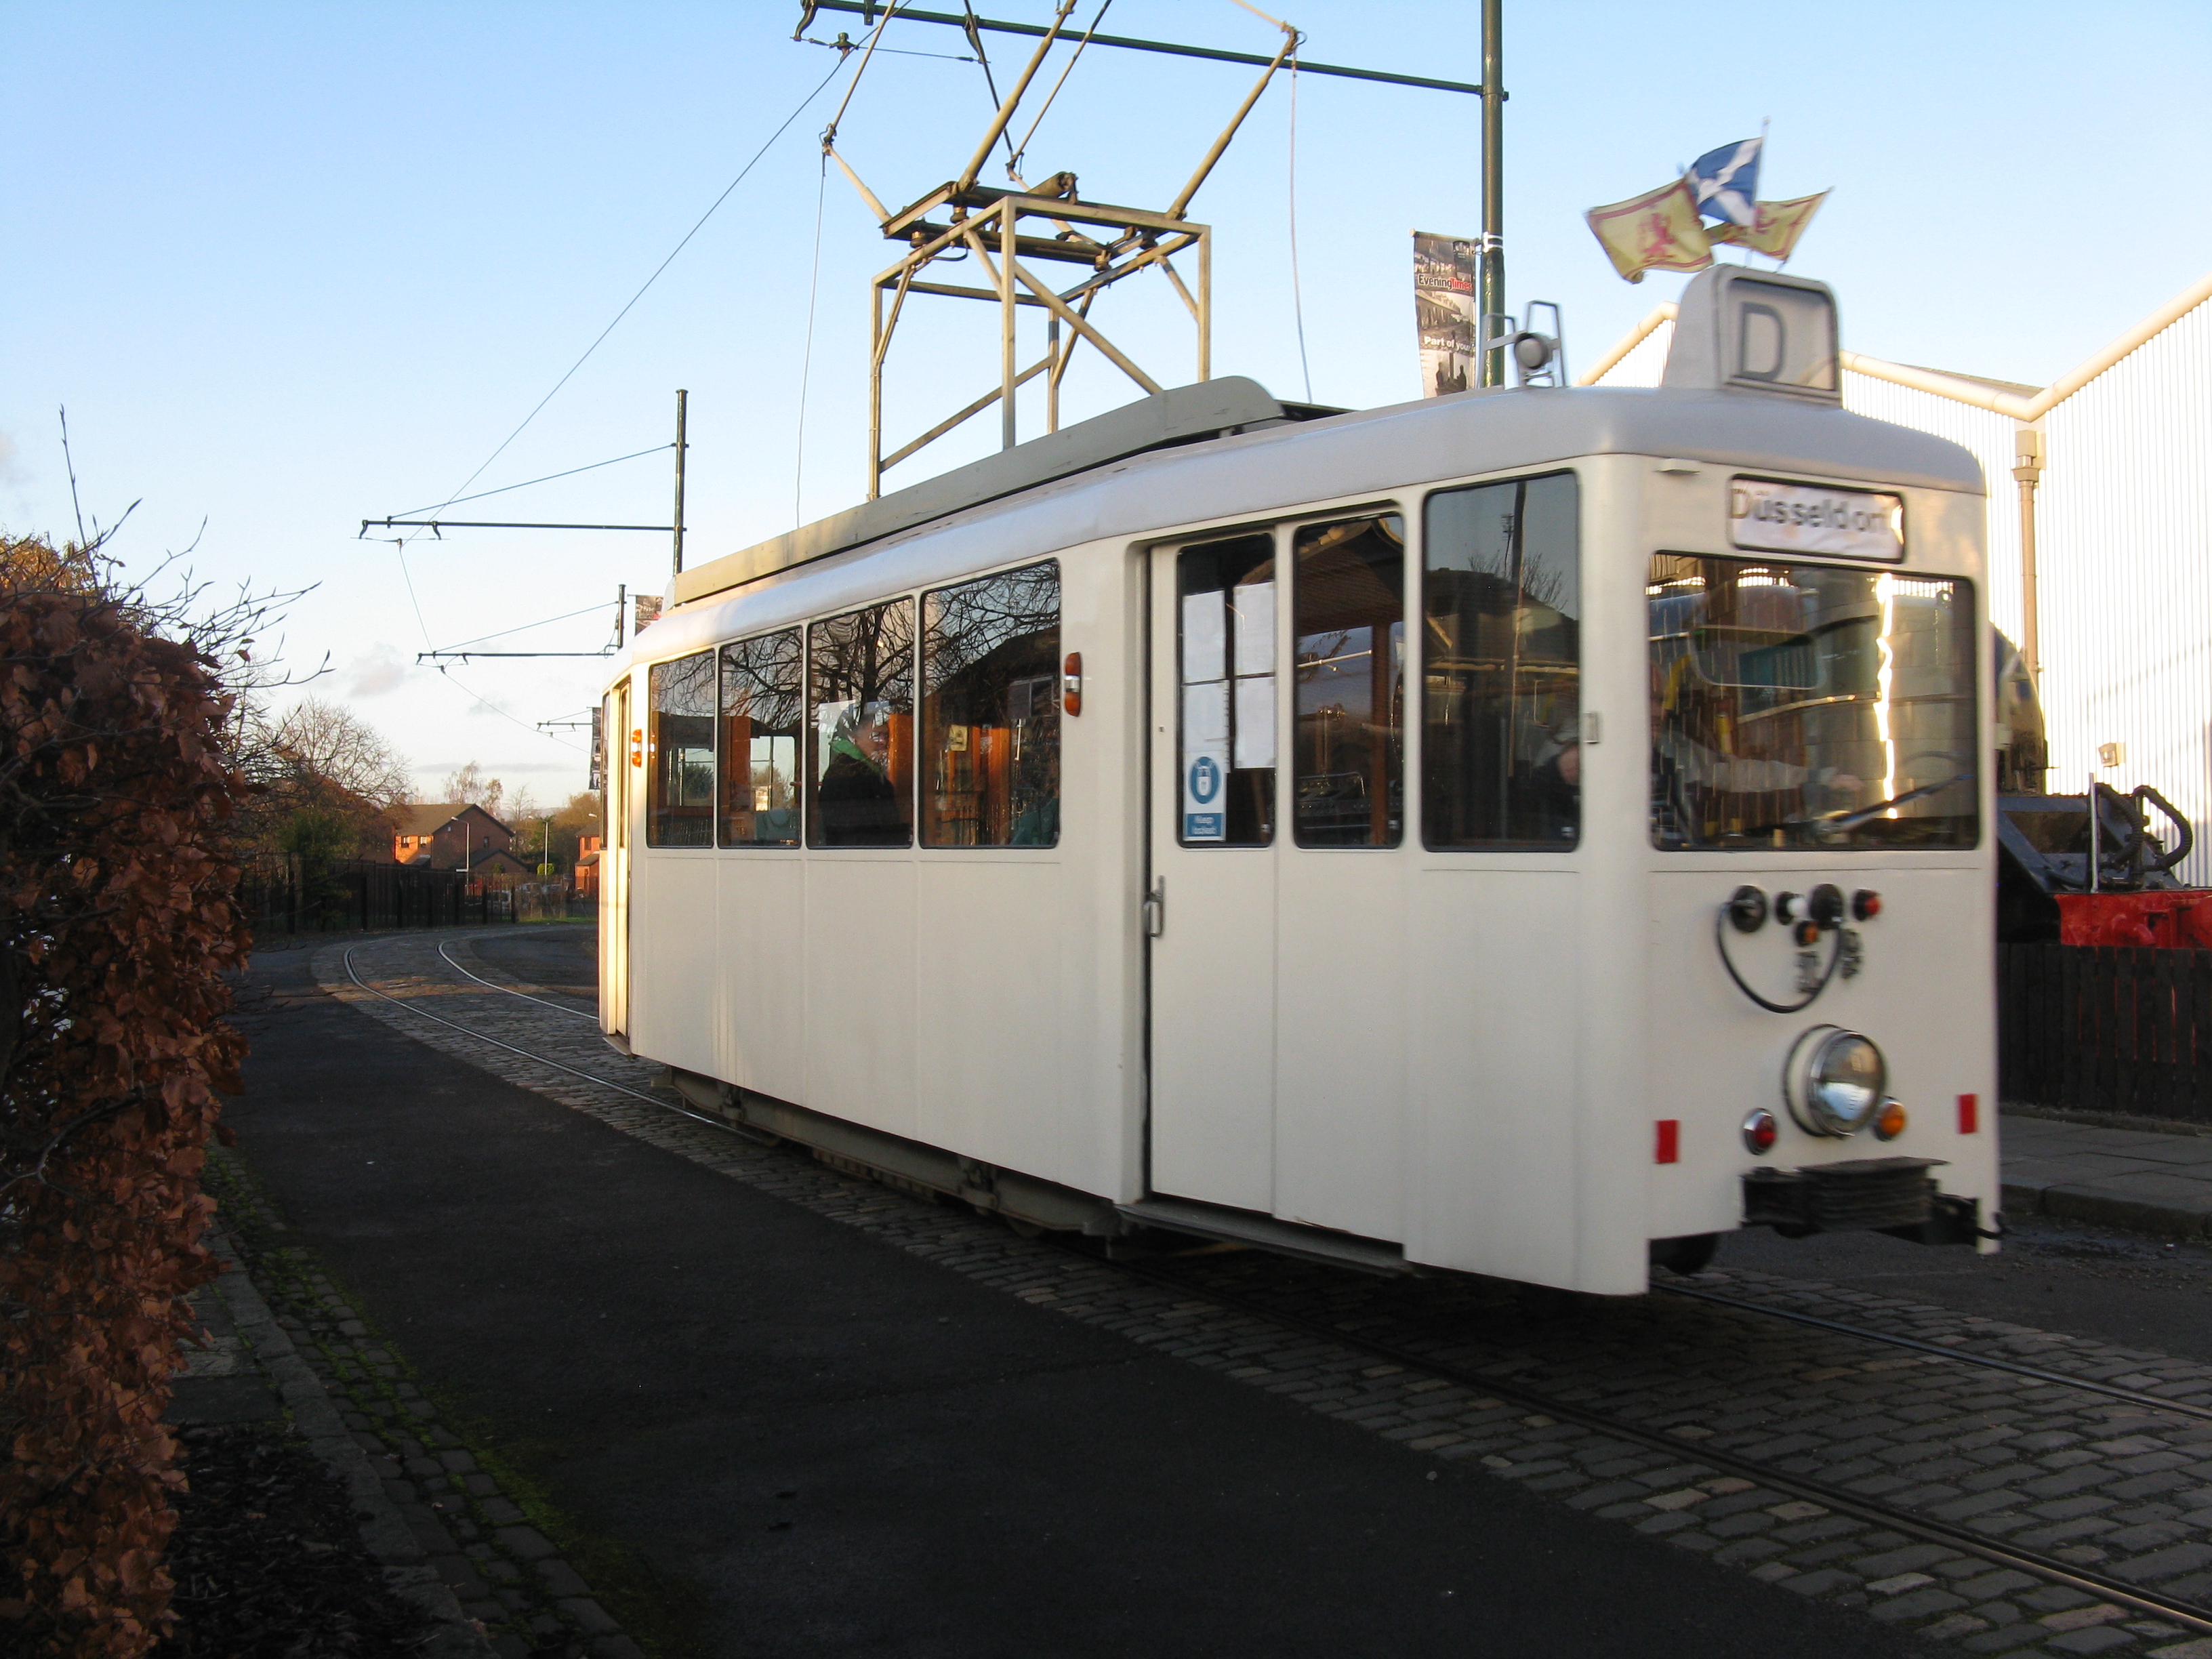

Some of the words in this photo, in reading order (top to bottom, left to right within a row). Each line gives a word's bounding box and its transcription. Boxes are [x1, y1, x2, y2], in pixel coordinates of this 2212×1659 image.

[1424, 336, 1445, 346] Part
[1447, 340, 1456, 348] of
[1456, 342, 1472, 352] your
[1740, 302, 1785, 382] D
